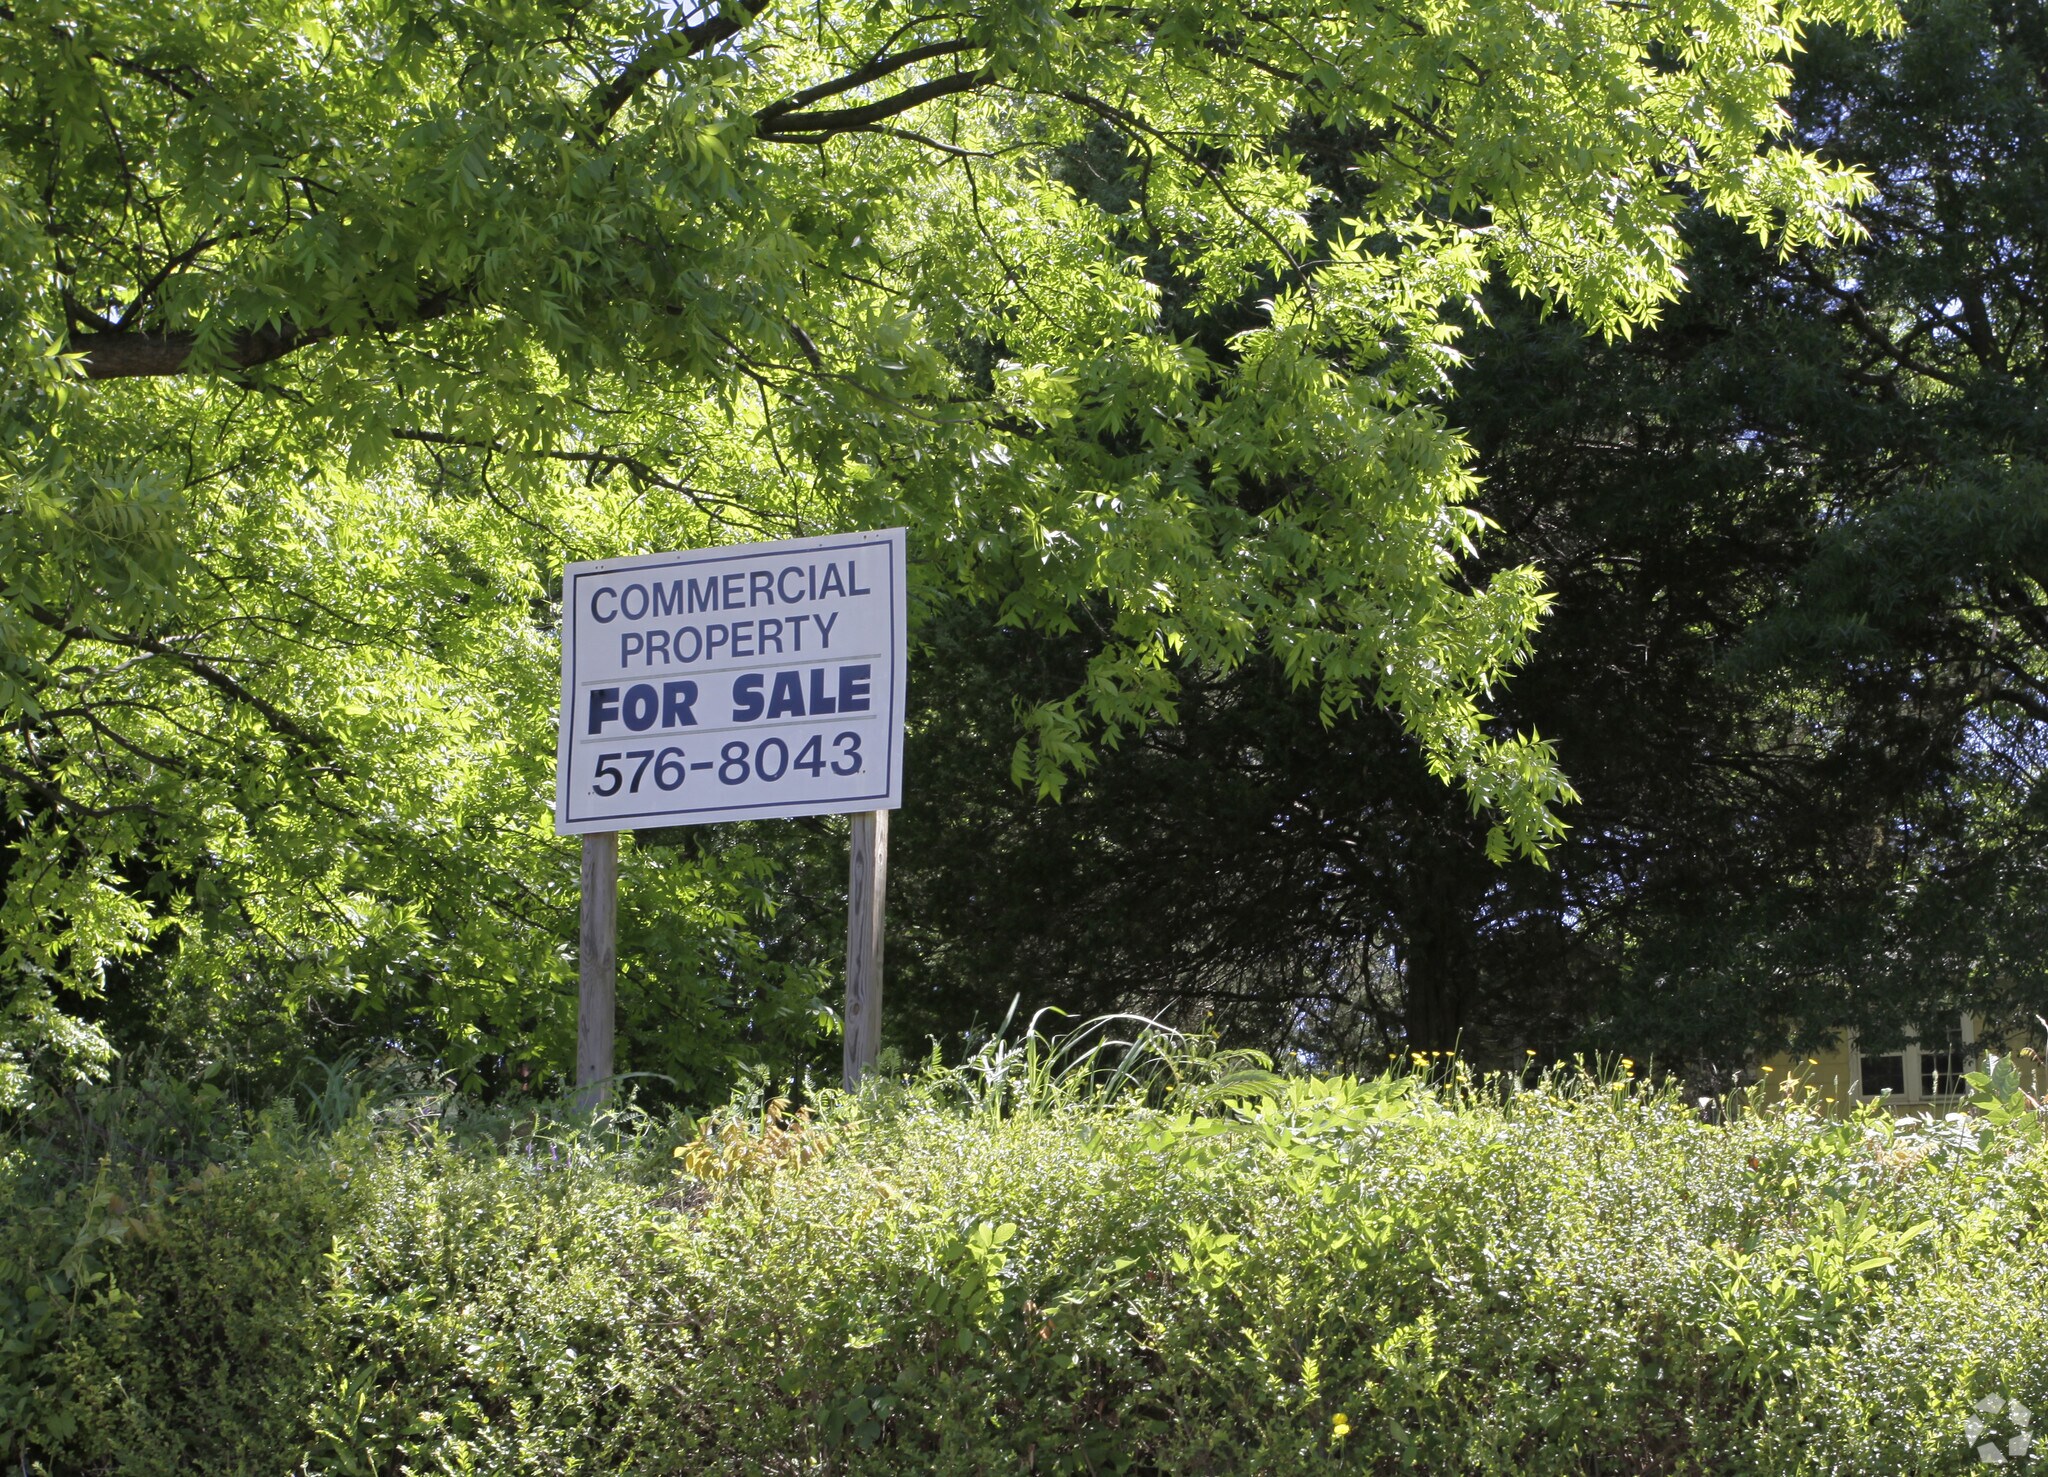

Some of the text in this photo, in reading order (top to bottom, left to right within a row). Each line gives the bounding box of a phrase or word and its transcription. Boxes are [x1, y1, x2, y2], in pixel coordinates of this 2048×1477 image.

[591, 560, 871, 624] COMMERCIAL
[621, 611, 839, 668] PROPERTY
[588, 664, 872, 735] FOR SALE
[592, 731, 863, 797] 576-8043
